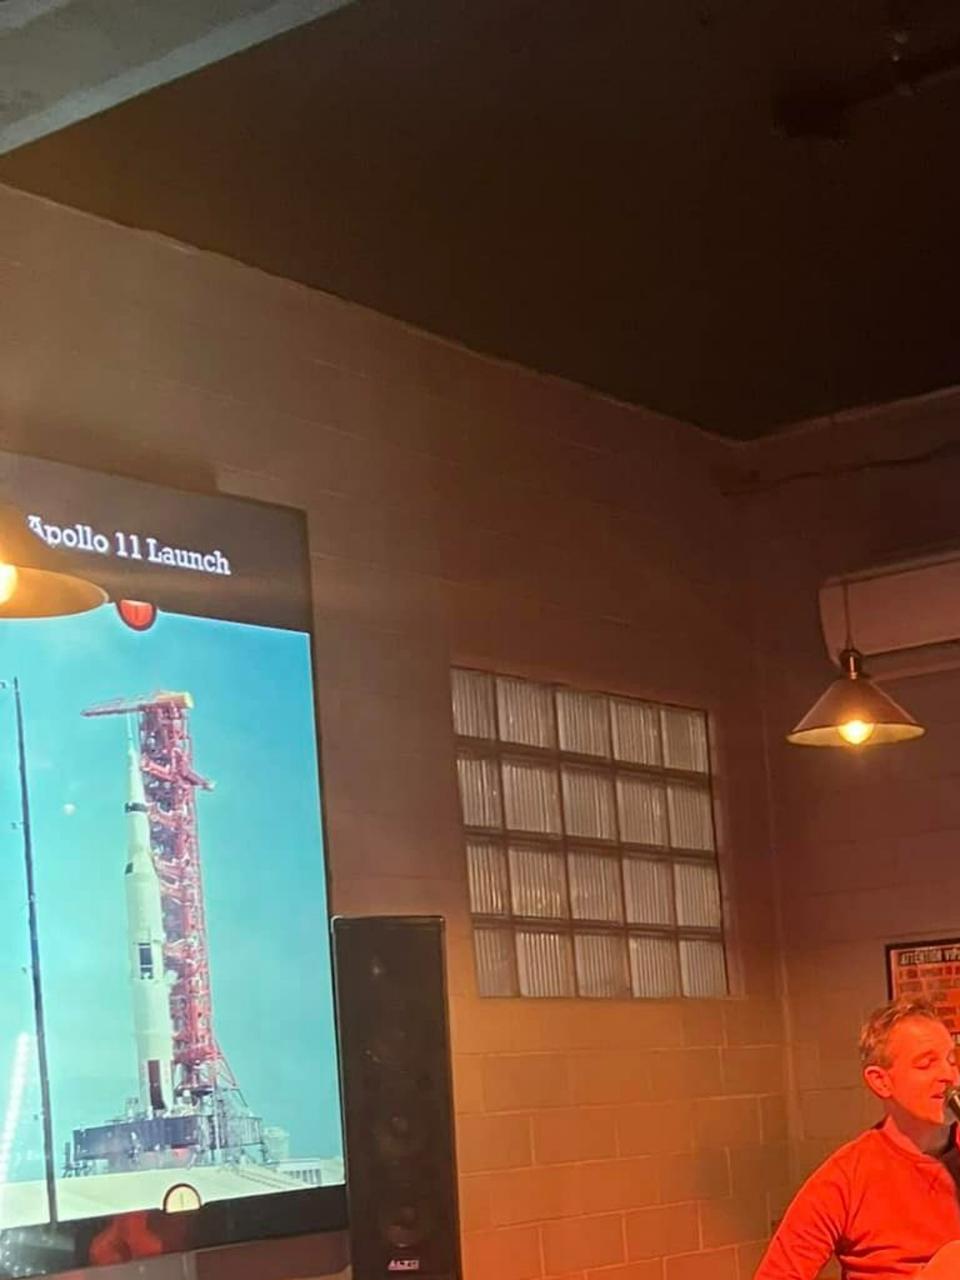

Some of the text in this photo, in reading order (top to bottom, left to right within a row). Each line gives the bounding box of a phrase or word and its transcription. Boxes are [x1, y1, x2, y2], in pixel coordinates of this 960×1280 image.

[28, 515, 231, 576] Apollo 11 Launch
